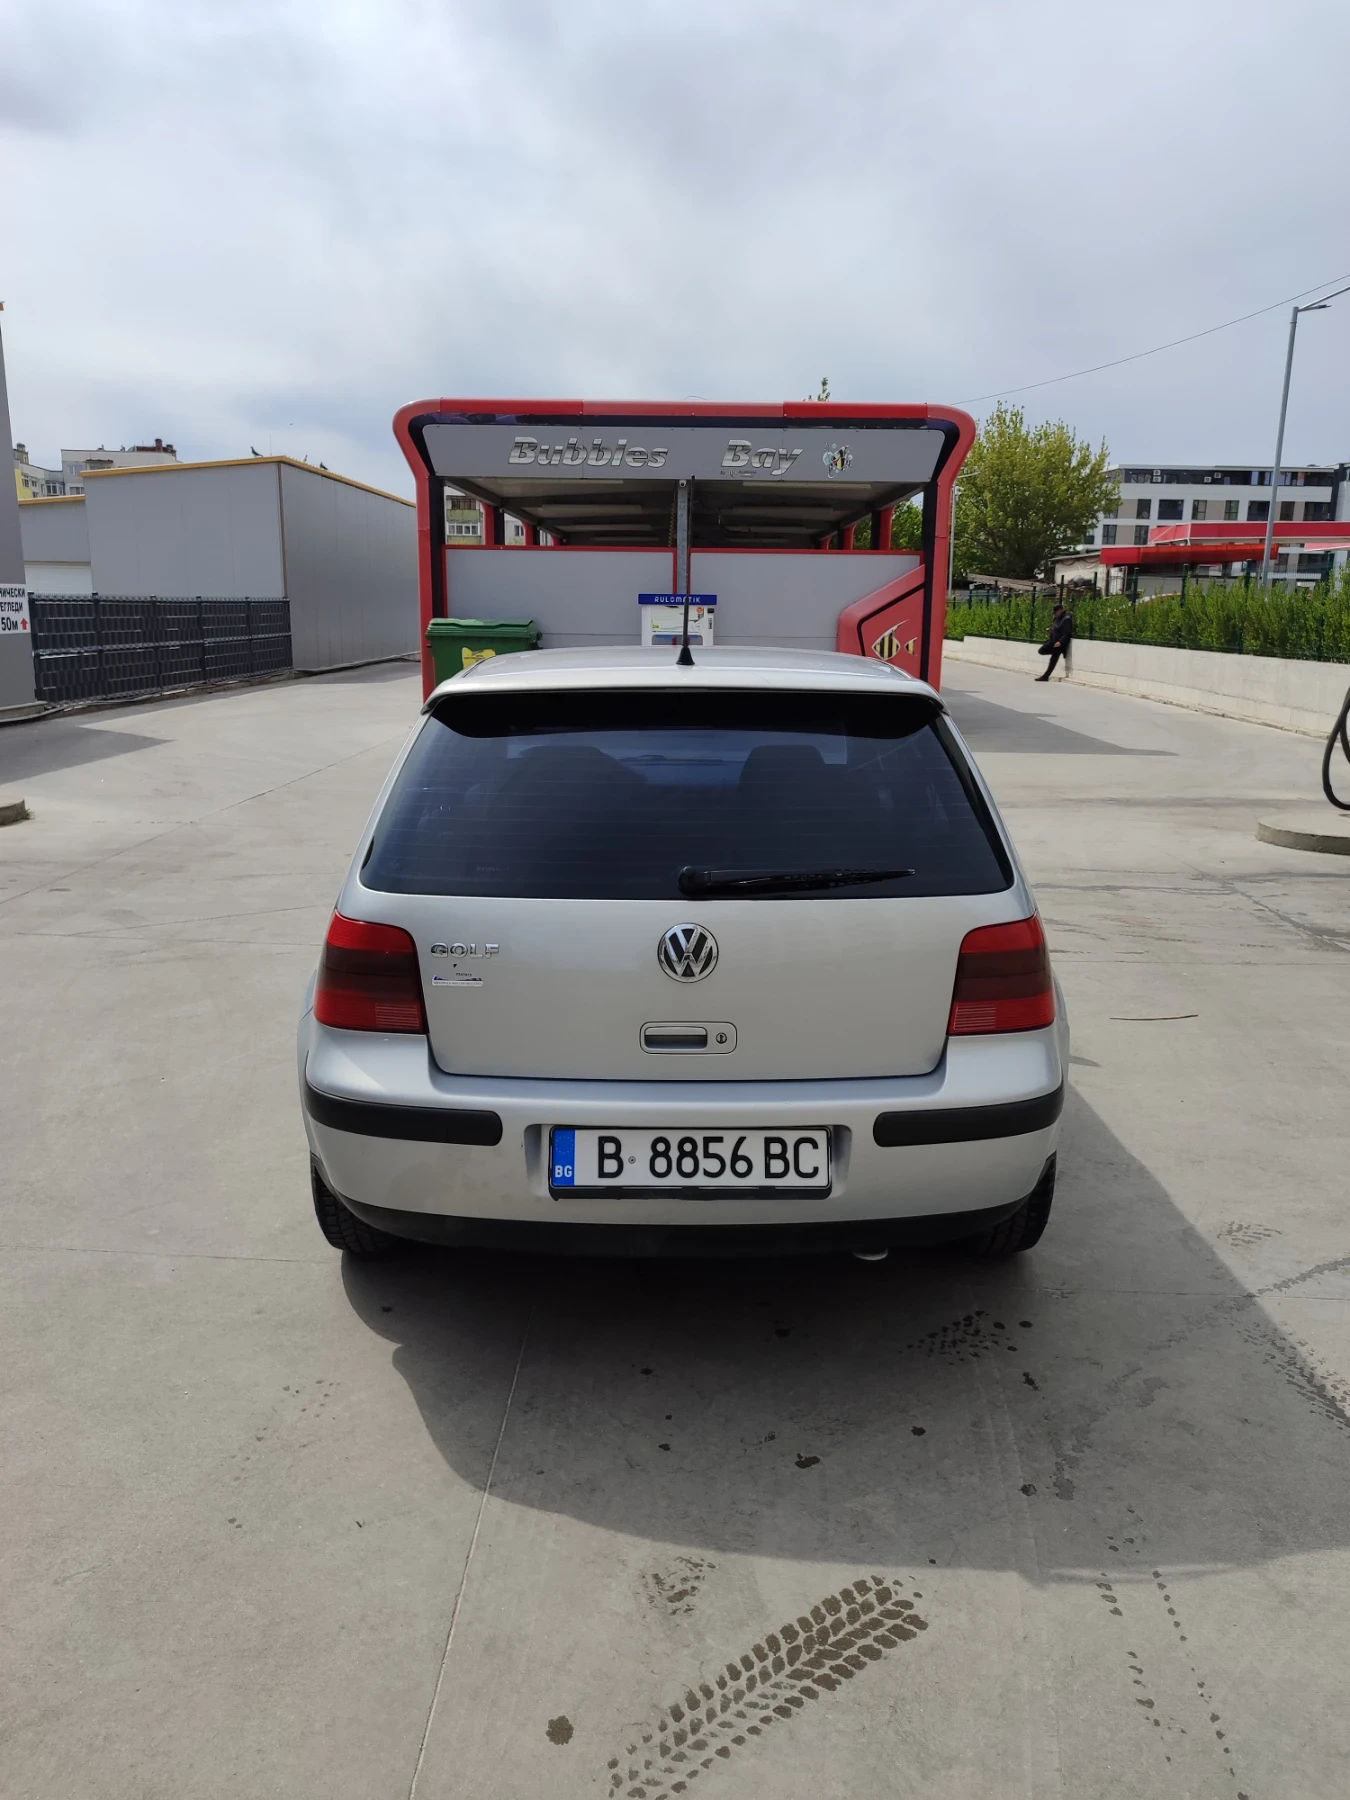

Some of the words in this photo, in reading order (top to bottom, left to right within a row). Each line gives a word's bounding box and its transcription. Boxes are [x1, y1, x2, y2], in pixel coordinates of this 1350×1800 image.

[508, 436, 669, 468] Bubbles
[720, 439, 804, 476] Bay
[0, 601, 23, 613] ЕГЛЕДИ
[430, 942, 499, 959] GOLF
[597, 1136, 624, 1179] B
[649, 1136, 753, 1179] 8856
[763, 1136, 820, 1179] BC
[554, 1165, 573, 1178] BG
